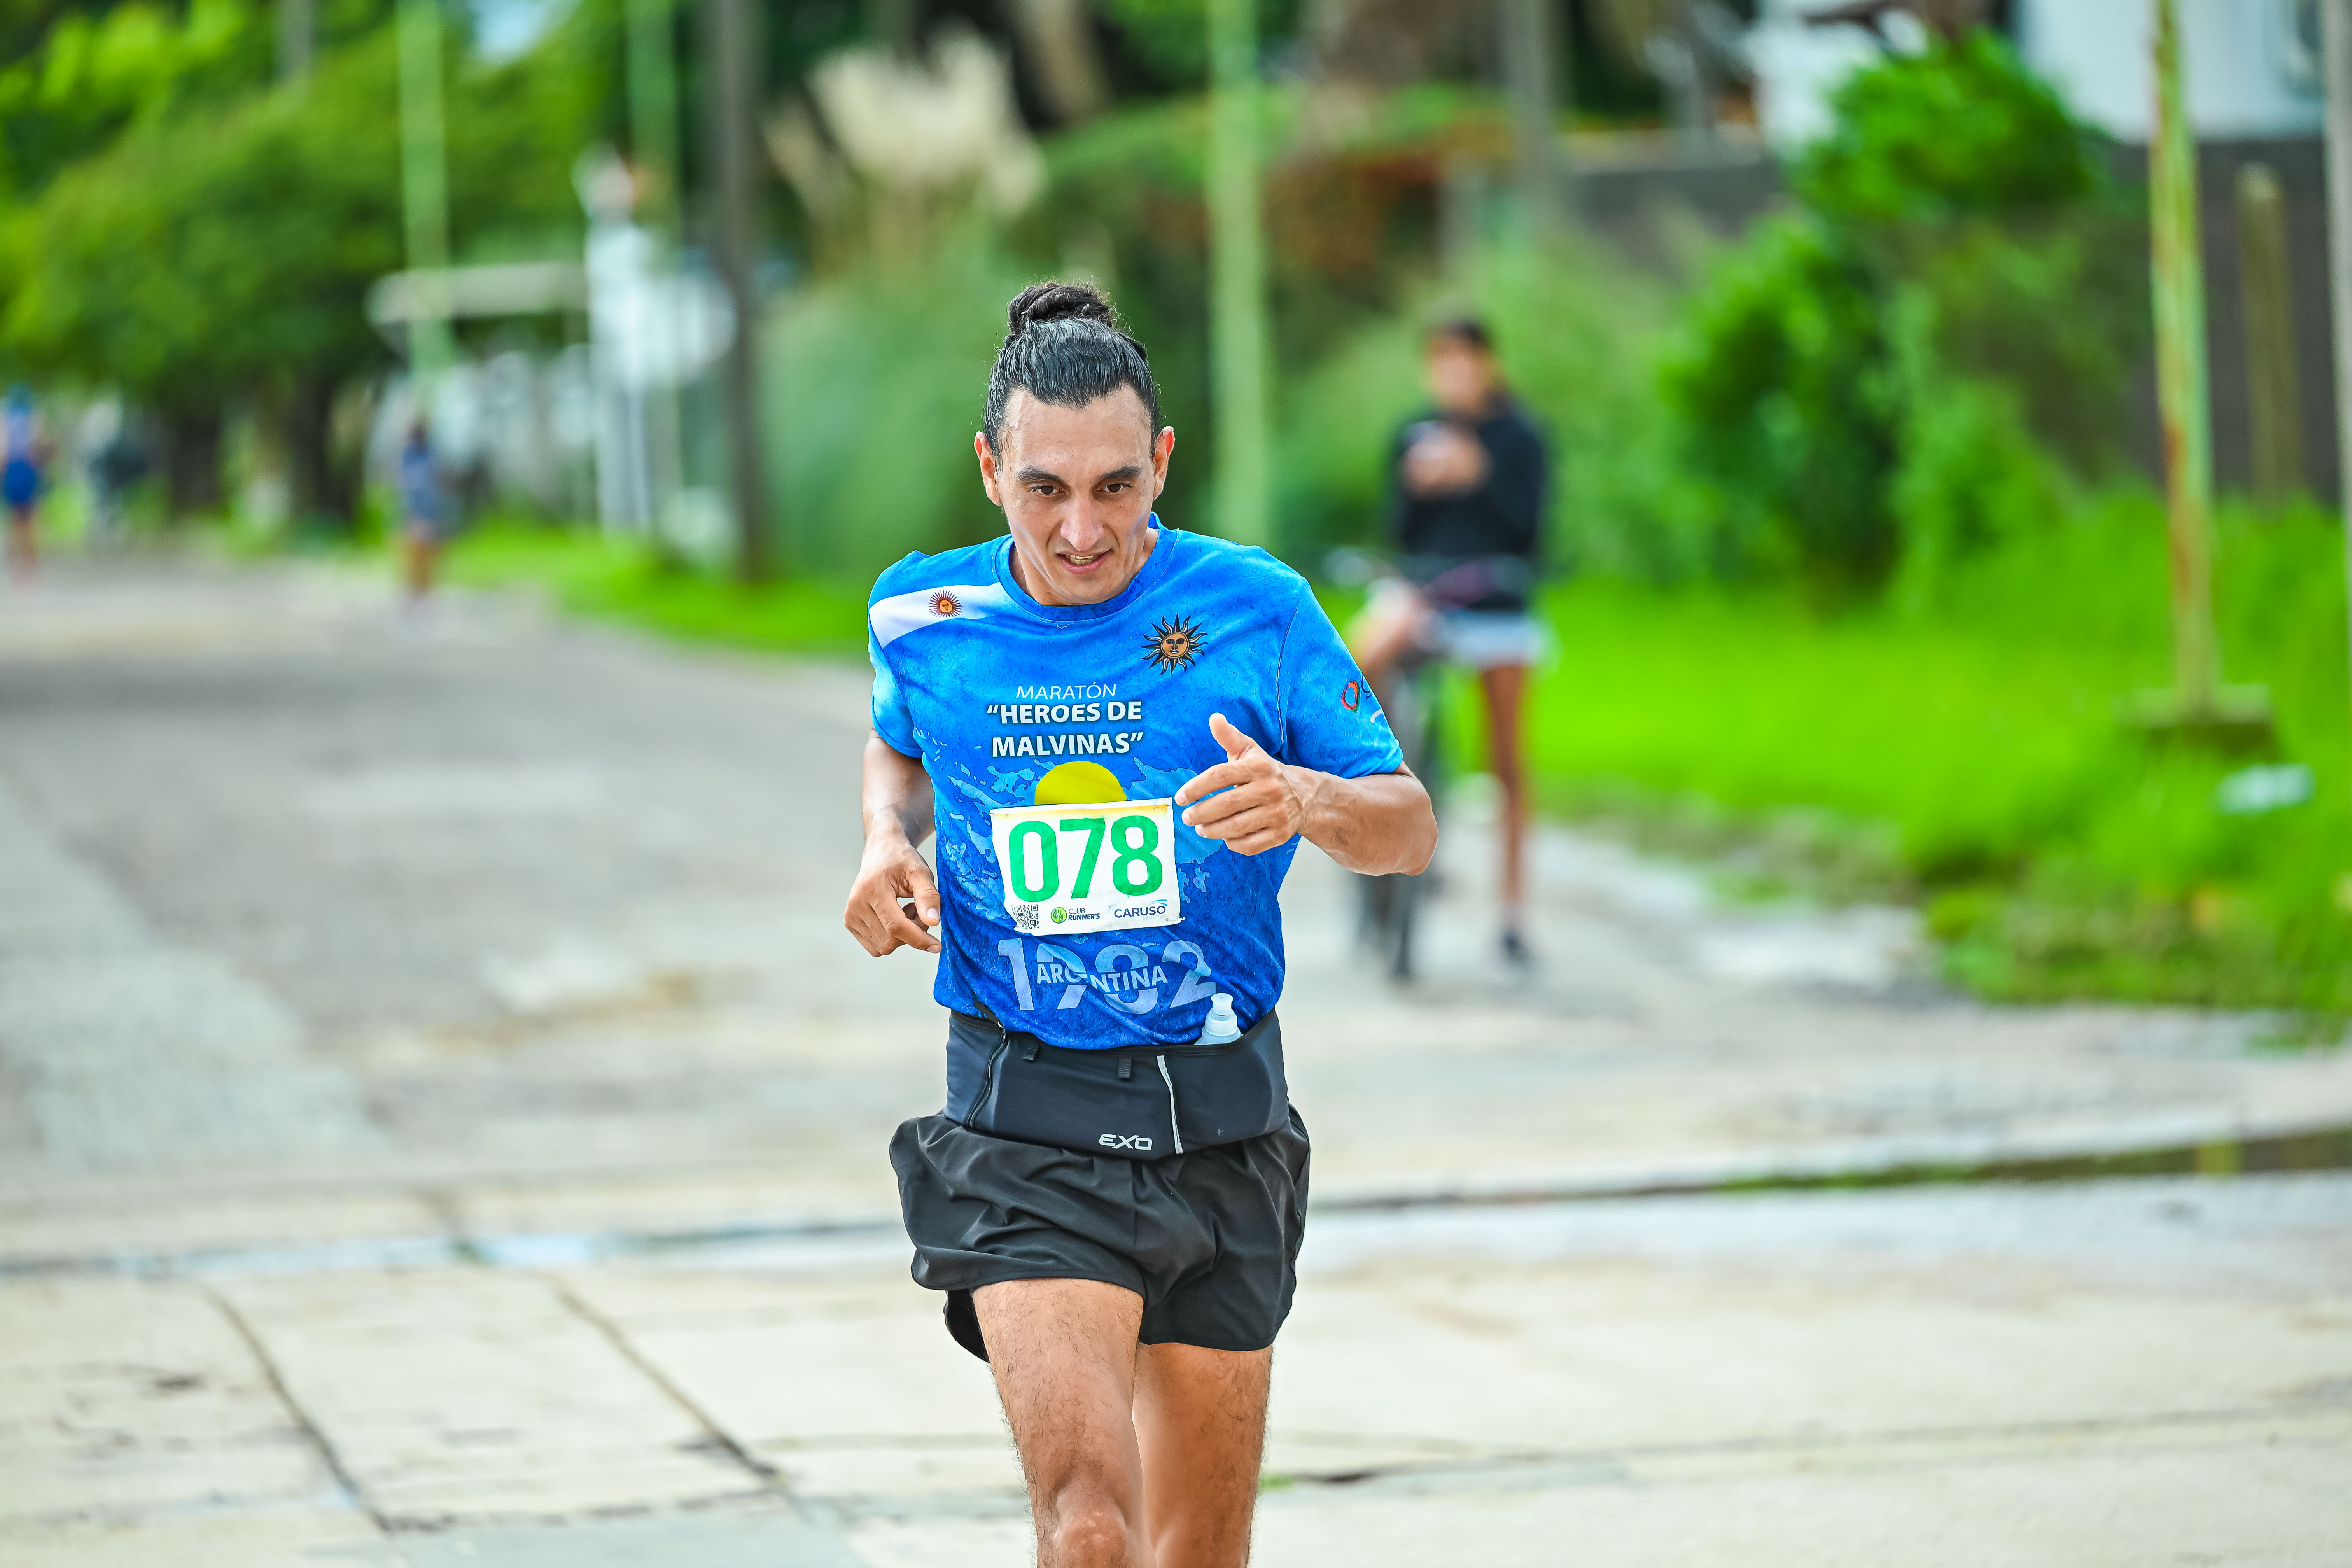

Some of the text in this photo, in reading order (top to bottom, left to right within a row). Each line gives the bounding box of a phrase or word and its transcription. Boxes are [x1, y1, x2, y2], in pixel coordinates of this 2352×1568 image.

[1016, 682, 1116, 700] MARATÓN
[1108, 701, 1142, 721] DE
[1009, 816, 1163, 902] 078
[1114, 906, 1166, 918] CARUSO
[1099, 1134, 1153, 1150] EXO
